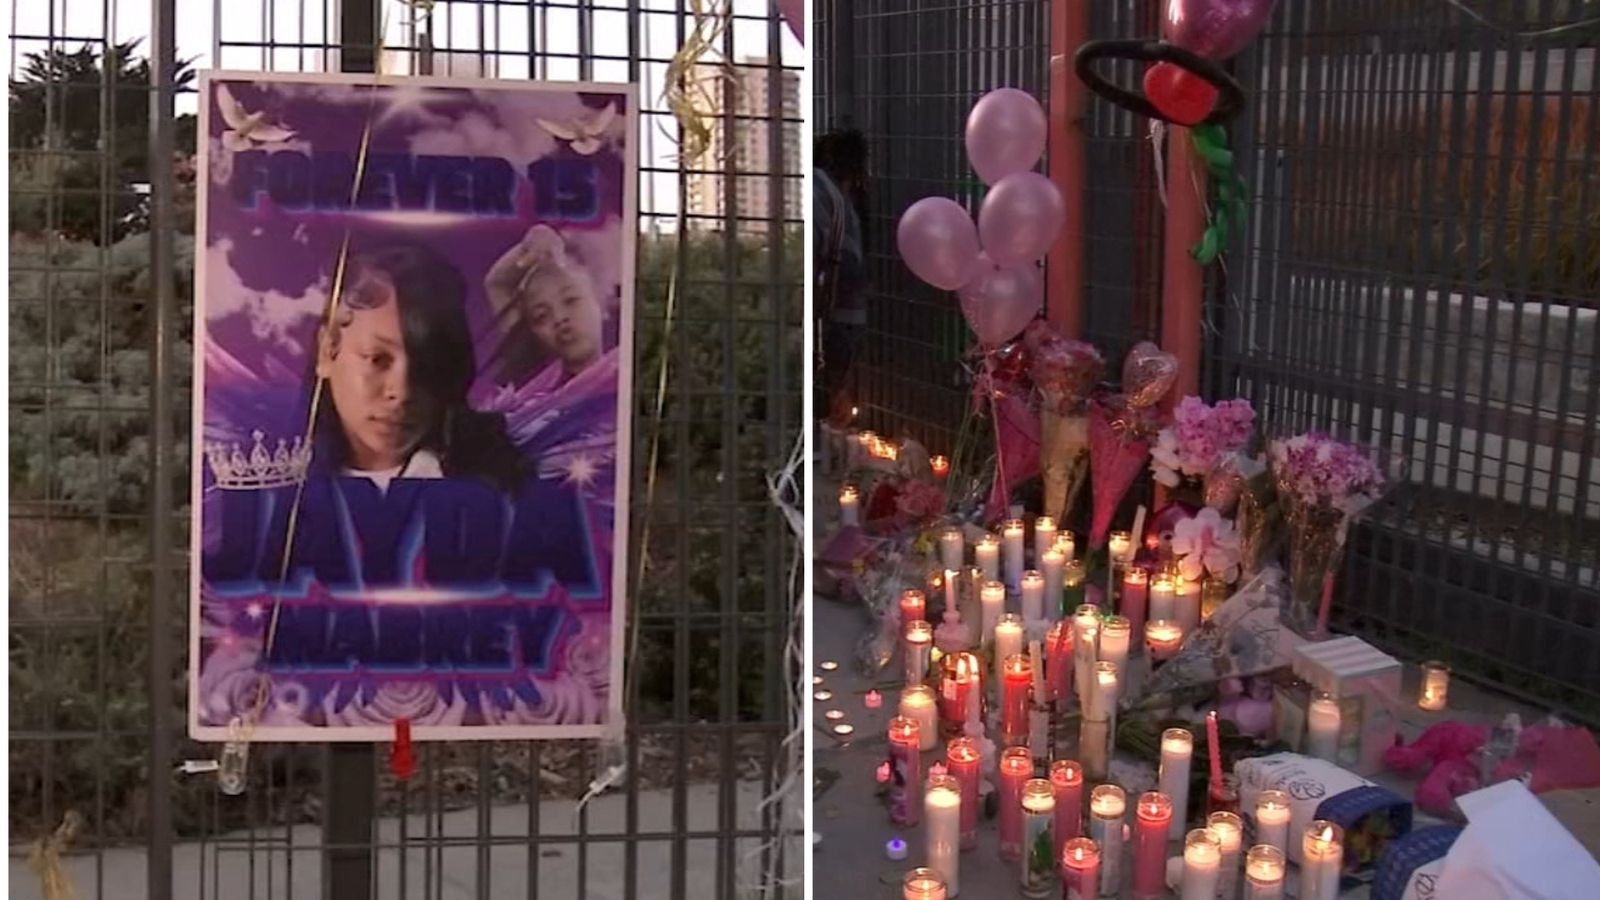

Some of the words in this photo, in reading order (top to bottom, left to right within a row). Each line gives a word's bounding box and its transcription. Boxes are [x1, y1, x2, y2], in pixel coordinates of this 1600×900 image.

[233, 150, 519, 218] FOREVER
[528, 155, 600, 222] 15
[202, 476, 602, 599] JAYDA
[263, 603, 566, 674] MABREY
